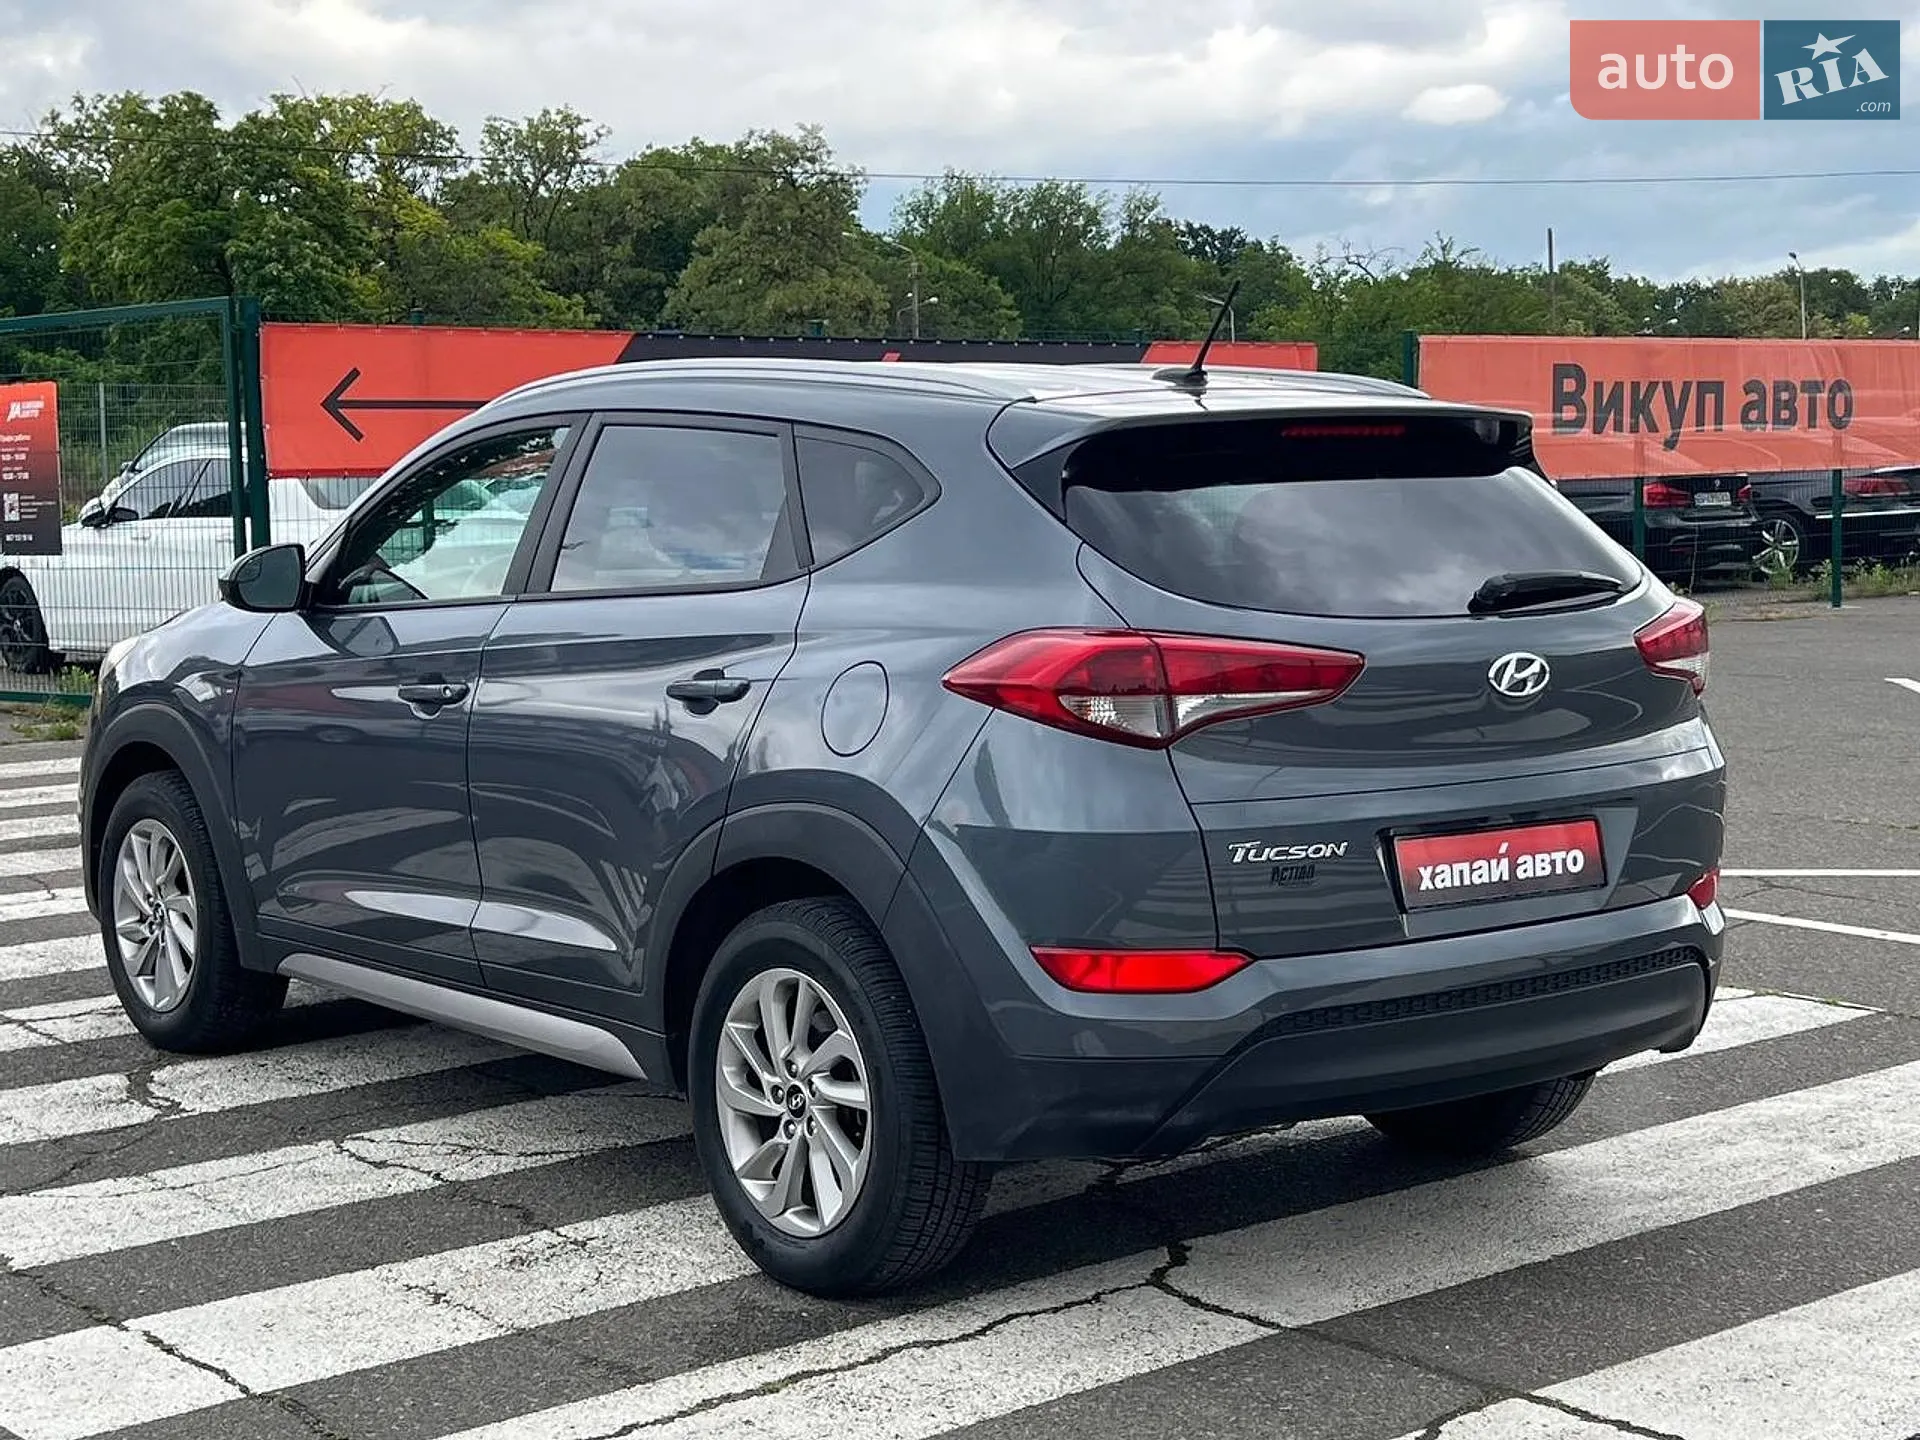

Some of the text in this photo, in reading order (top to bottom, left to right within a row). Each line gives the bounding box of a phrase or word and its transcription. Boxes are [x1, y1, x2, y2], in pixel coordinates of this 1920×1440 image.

[1551, 362, 1854, 450] Викуп авто
[1417, 842, 1585, 891] хапай авто
